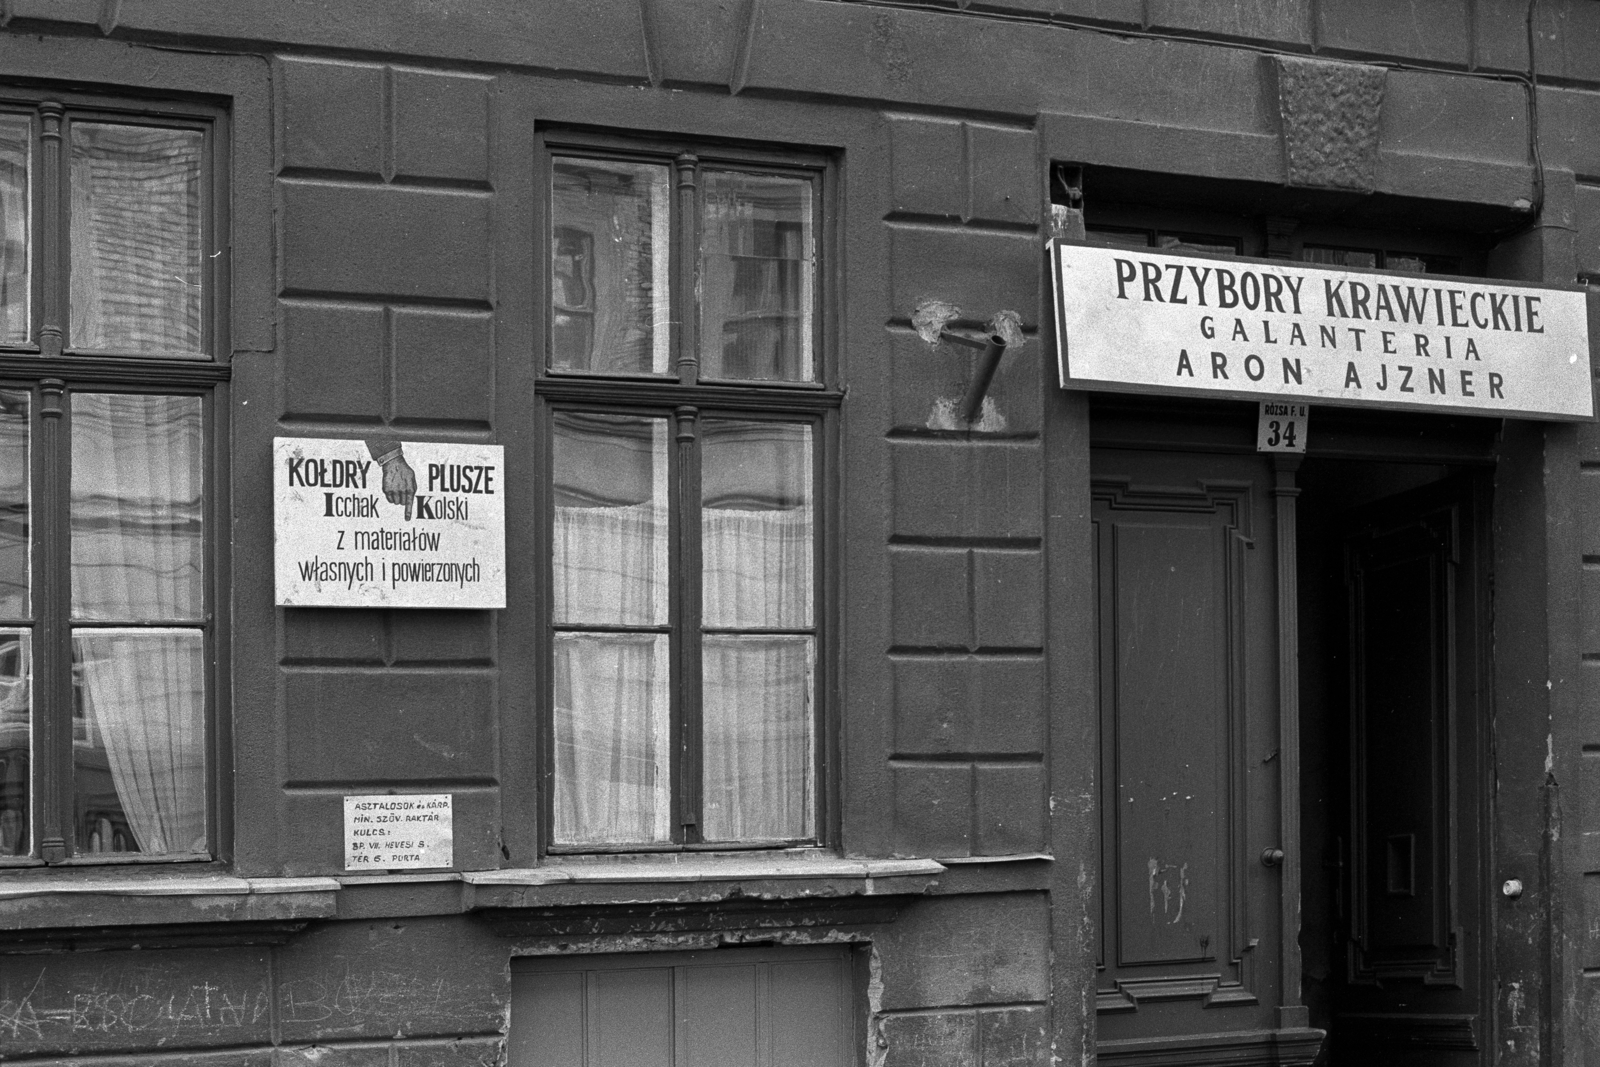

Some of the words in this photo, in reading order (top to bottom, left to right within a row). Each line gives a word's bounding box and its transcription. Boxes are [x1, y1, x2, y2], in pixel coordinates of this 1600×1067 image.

[1114, 258, 1304, 315] PRZYBORY
[1324, 279, 1544, 333] KRAWIECKIE
[1201, 316, 1481, 361] GALANTERIA
[1177, 349, 1302, 385] ARON
[1344, 361, 1504, 399] AJZNER
[1265, 402, 1288, 416] RÓZSA
[1267, 421, 1296, 447] 34
[288, 458, 371, 488] KOŁDRY
[429, 464, 495, 494] PLUSZE
[324, 493, 379, 518] Icchak
[416, 495, 468, 520] Kolski
[337, 530, 345, 550] z
[355, 528, 440, 551] materiałów
[299, 555, 373, 590] własnych
[382, 558, 386, 581] i
[392, 558, 480, 589] powierzonych
[355, 802, 414, 810] ASZTALOSOK
[406, 811, 439, 821] RAKTÁR
[352, 852, 369, 862] TÉR
[385, 841, 414, 849] HEVESI
